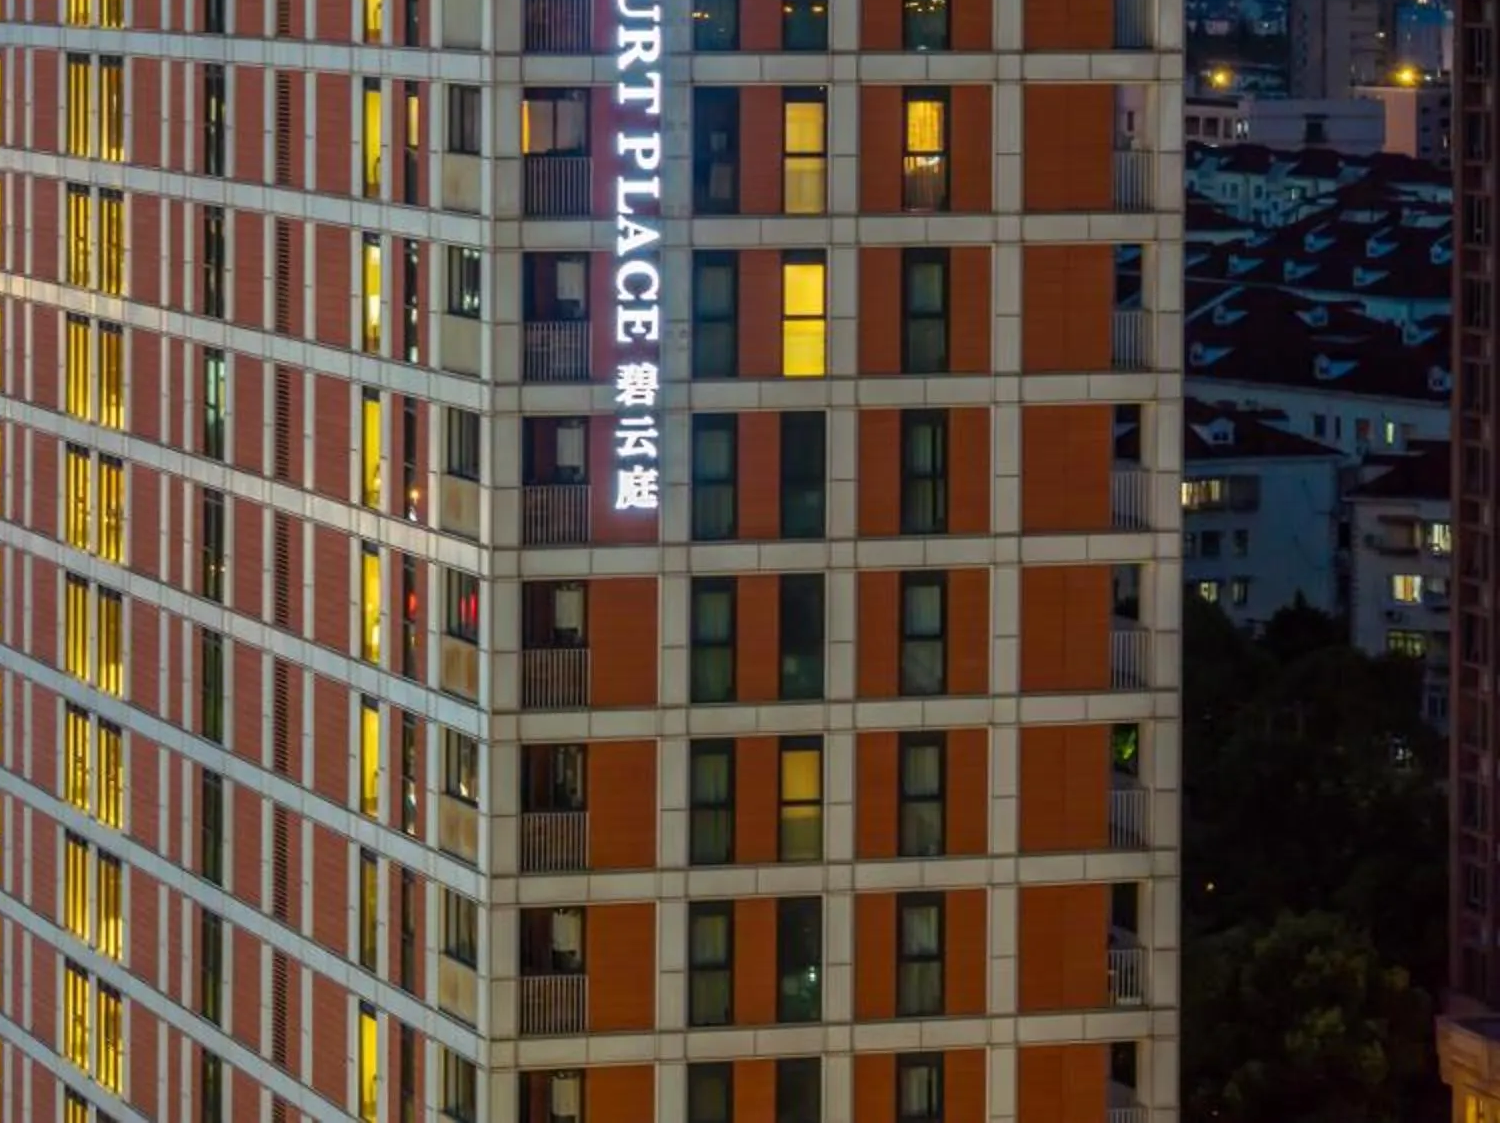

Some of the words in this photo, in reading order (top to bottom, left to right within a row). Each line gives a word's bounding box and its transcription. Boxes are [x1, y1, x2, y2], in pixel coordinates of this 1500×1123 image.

[615, 131, 661, 344] PLACE
[614, 361, 660, 511] 碧云庭
